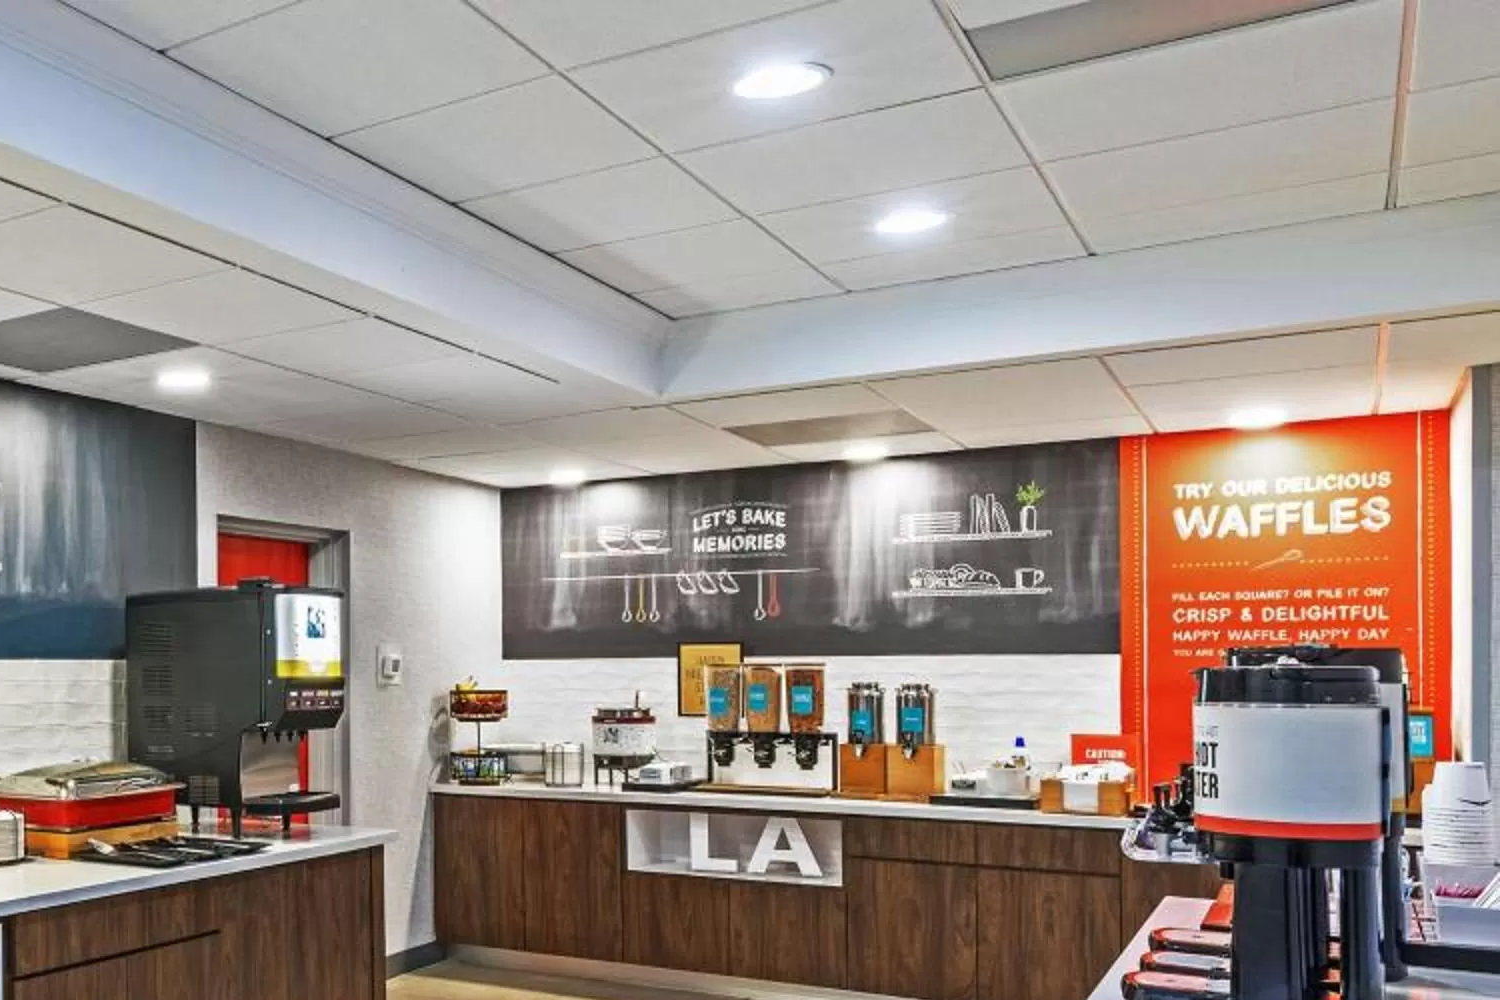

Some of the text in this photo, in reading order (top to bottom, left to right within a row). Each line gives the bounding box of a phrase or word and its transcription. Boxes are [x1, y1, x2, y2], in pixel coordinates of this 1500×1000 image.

[1172, 471, 1392, 500] TRY OUR DELICIOUS
[692, 508, 787, 532] LET'S BAKE
[1172, 496, 1392, 541] WAFFLES
[693, 533, 787, 553] MEMORIES
[1199, 591, 1230, 602] EACH
[1235, 589, 1289, 601] SQUARE?
[1293, 589, 1312, 599] OR
[1317, 588, 1342, 599] PILE
[1347, 588, 1359, 598] IT
[1364, 587, 1389, 597] ON?
[1172, 604, 1389, 623] CRISP & DELIGHTFUL
[1172, 627, 1389, 643] HAPPY WAFFLE, HAPPY DAY
[1195, 772, 1219, 799] TER
[690, 812, 823, 877] LA
